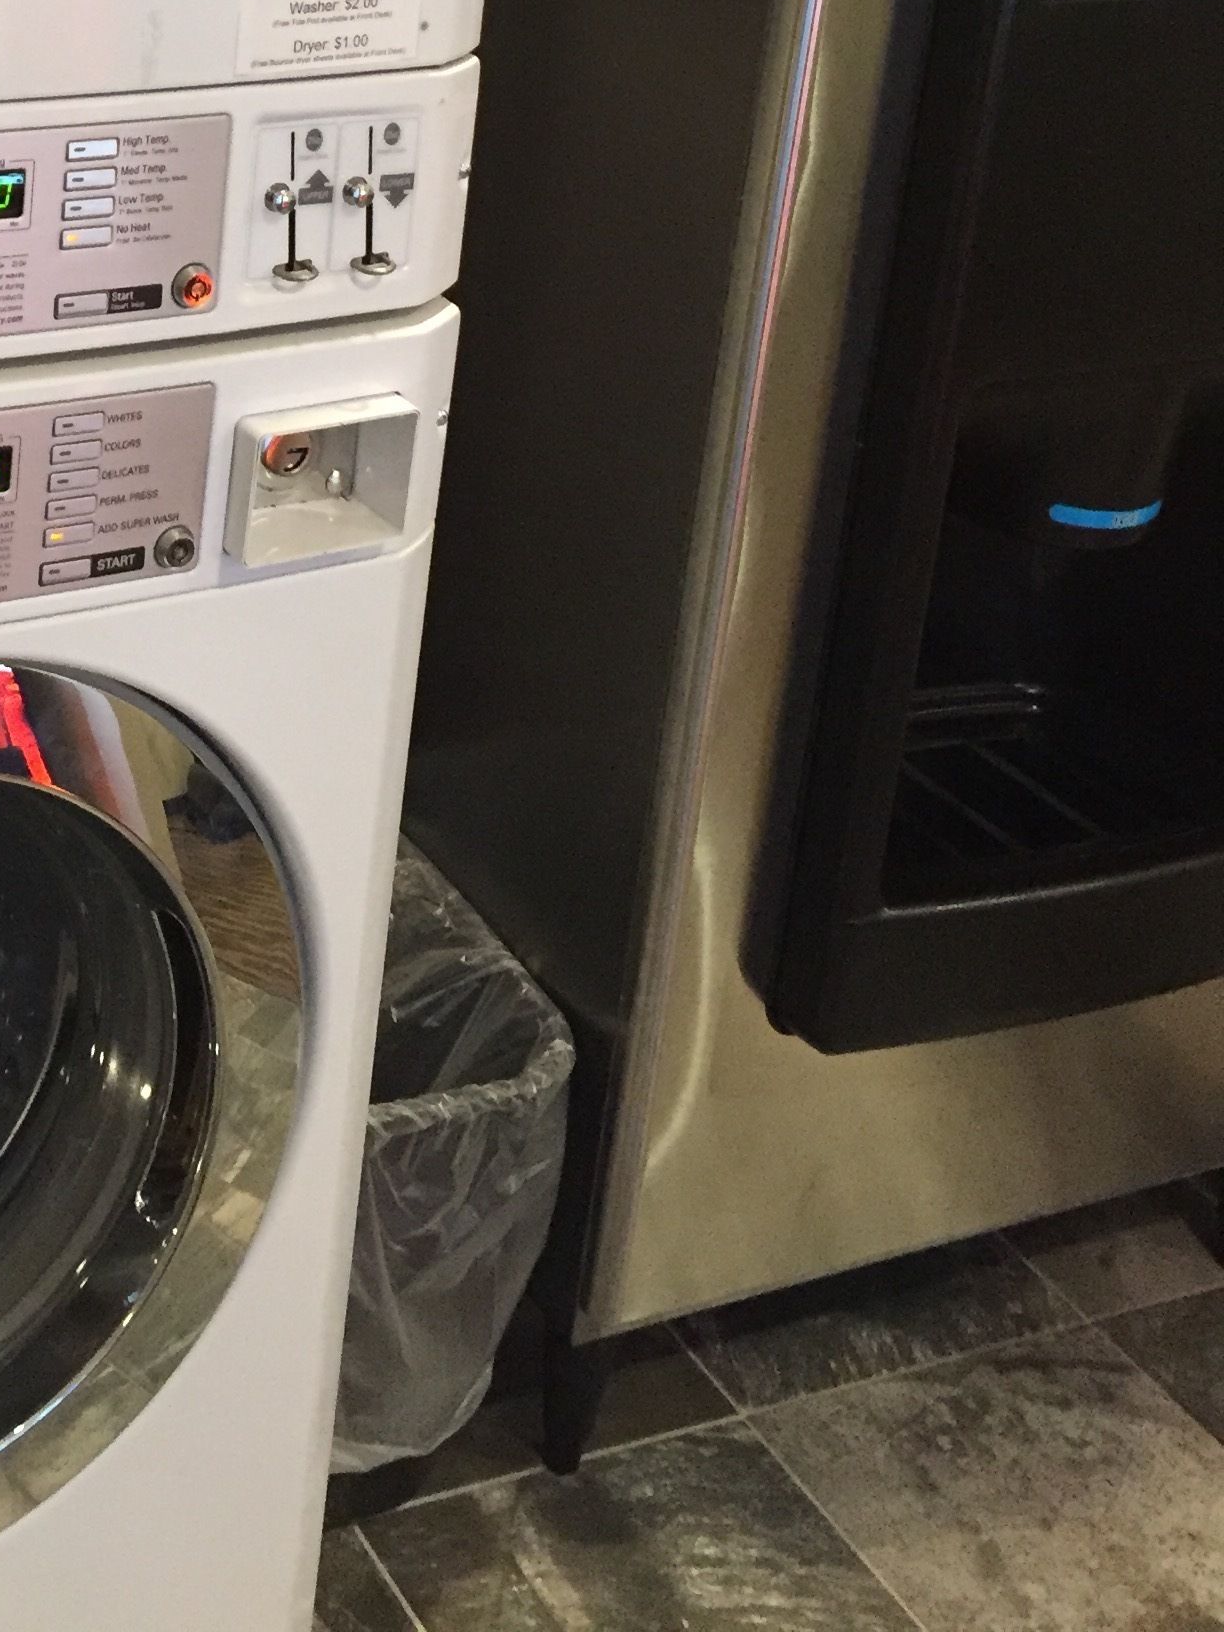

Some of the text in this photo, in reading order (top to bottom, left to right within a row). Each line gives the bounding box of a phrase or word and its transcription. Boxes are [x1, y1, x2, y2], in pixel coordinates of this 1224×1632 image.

[122, 136, 143, 148] High
[120, 166, 140, 176] Med
[118, 196, 138, 206] Low
[116, 222, 151, 234] No Heat
[111, 290, 134, 303] Start
[107, 410, 143, 424] WHITES
[104, 438, 141, 452] COLORS
[101, 464, 150, 480] DELICATES
[129, 489, 159, 502] PRESS
[97, 512, 180, 535] ADD SUPER WASH
[97, 553, 136, 571] START
